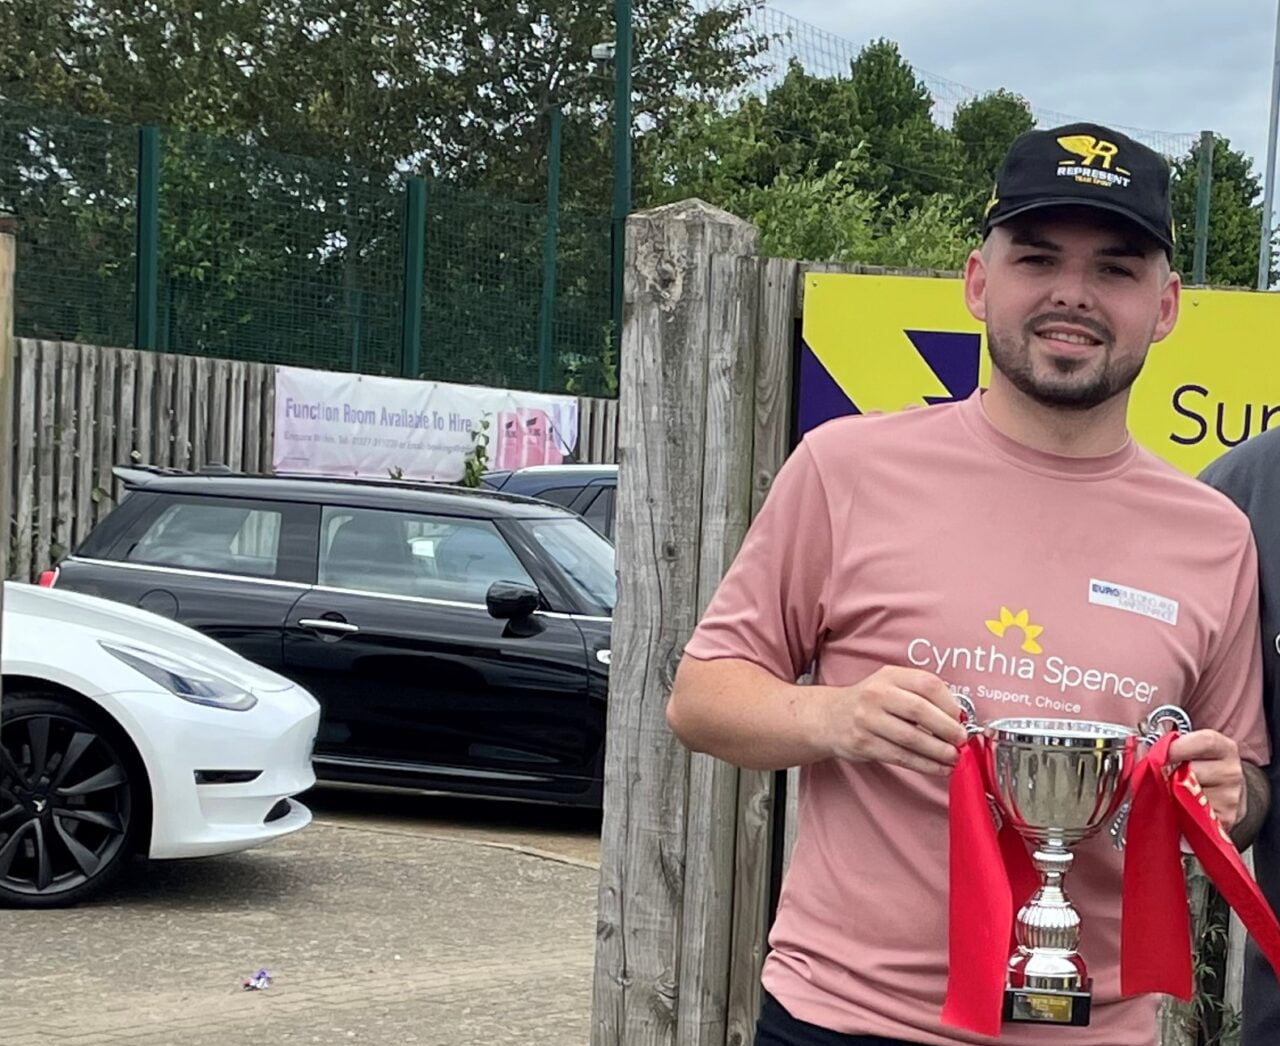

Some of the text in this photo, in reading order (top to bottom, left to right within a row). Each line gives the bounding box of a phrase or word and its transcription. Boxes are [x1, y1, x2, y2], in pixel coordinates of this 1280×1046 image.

[1056, 166, 1131, 188] REPRESENT
[285, 398, 472, 433] Function Room Available To Hire
[907, 638, 1158, 704] Cynthia Spencer
[1035, 695, 1082, 713] Choice
